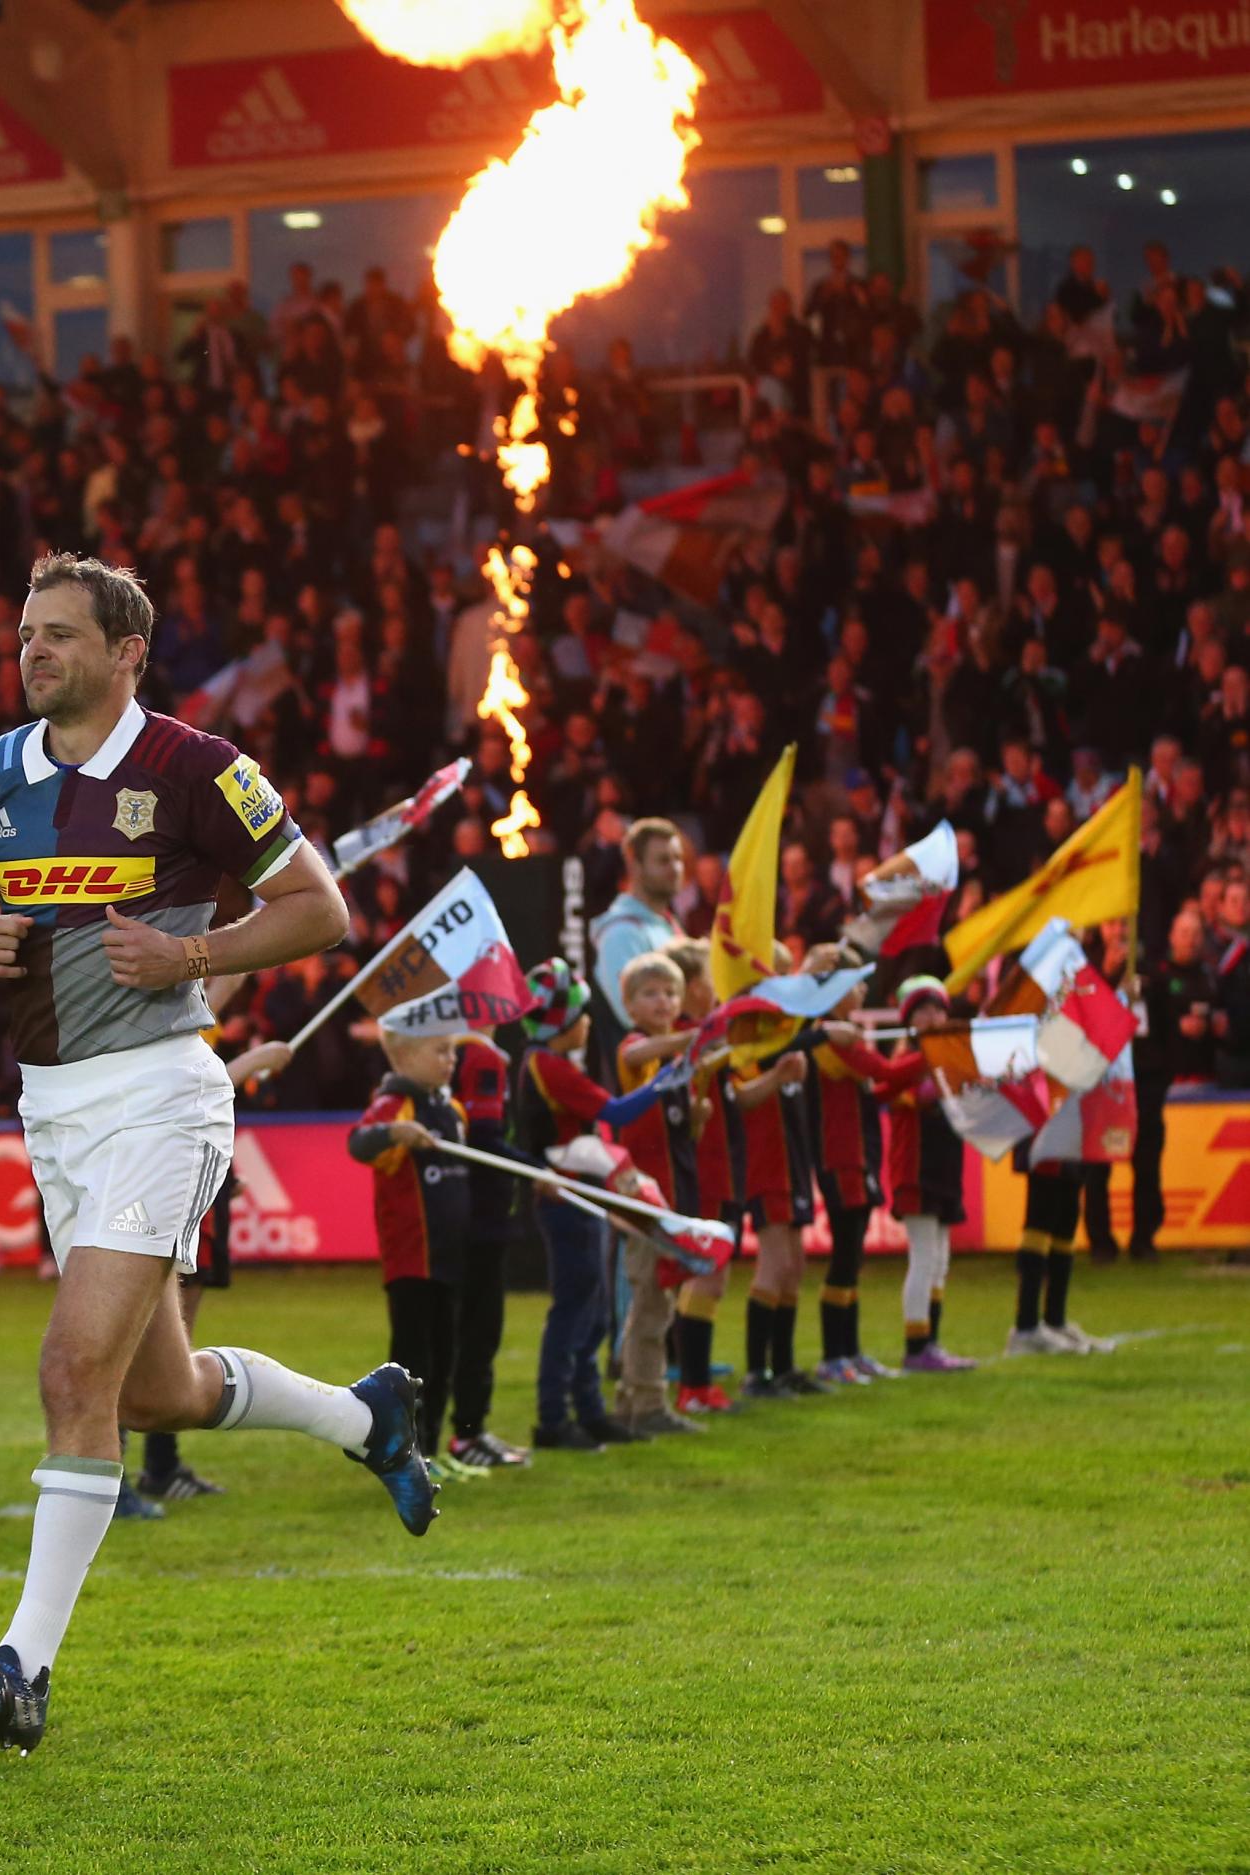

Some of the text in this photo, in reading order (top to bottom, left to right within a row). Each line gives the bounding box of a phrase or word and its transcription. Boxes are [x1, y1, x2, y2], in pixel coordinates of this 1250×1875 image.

[2, 866, 127, 897] DHL
[108, 1219, 158, 1236] adidas
[228, 1212, 318, 1254] das
